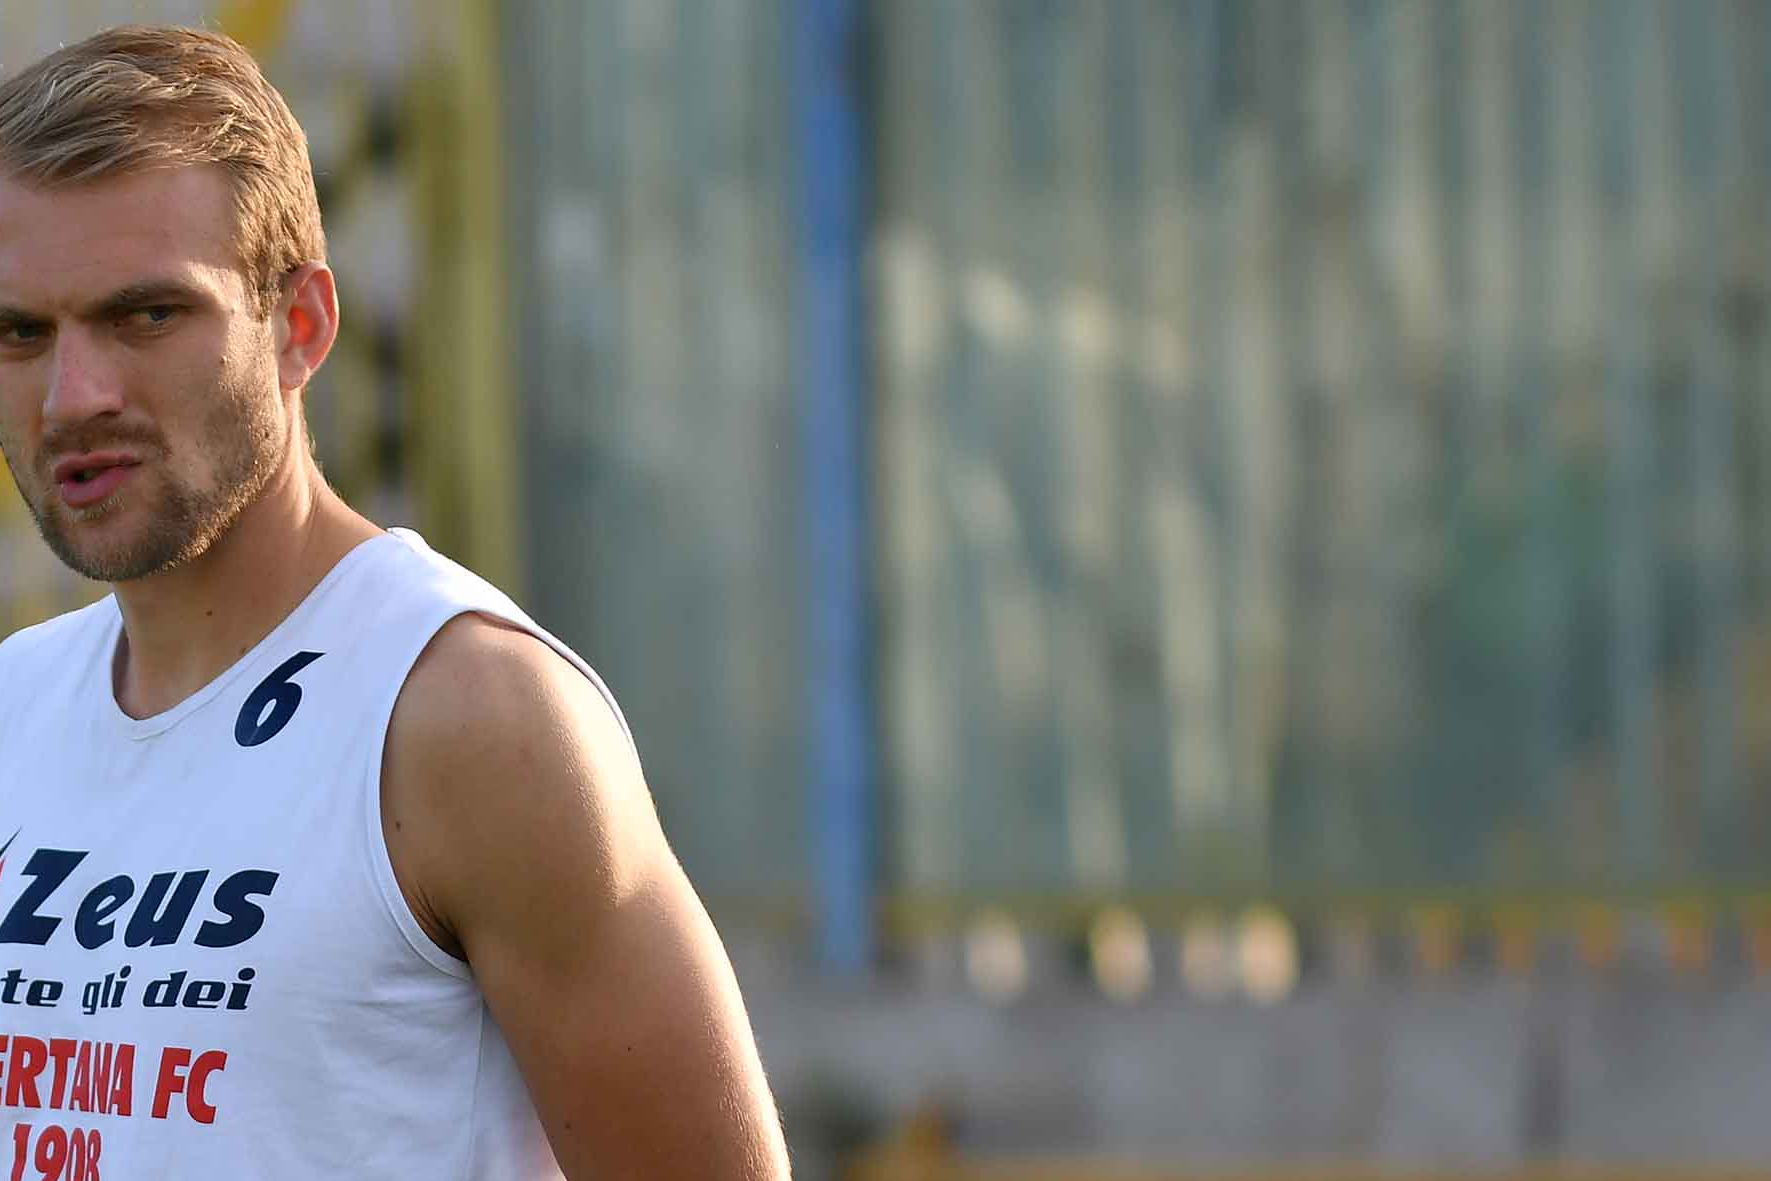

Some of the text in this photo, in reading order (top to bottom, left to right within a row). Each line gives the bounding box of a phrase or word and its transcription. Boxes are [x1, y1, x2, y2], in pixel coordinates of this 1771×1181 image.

[233, 651, 327, 748] 6
[82, 965, 132, 1015] gli
[142, 967, 256, 1010] dei
[151, 1047, 228, 1125] FC
